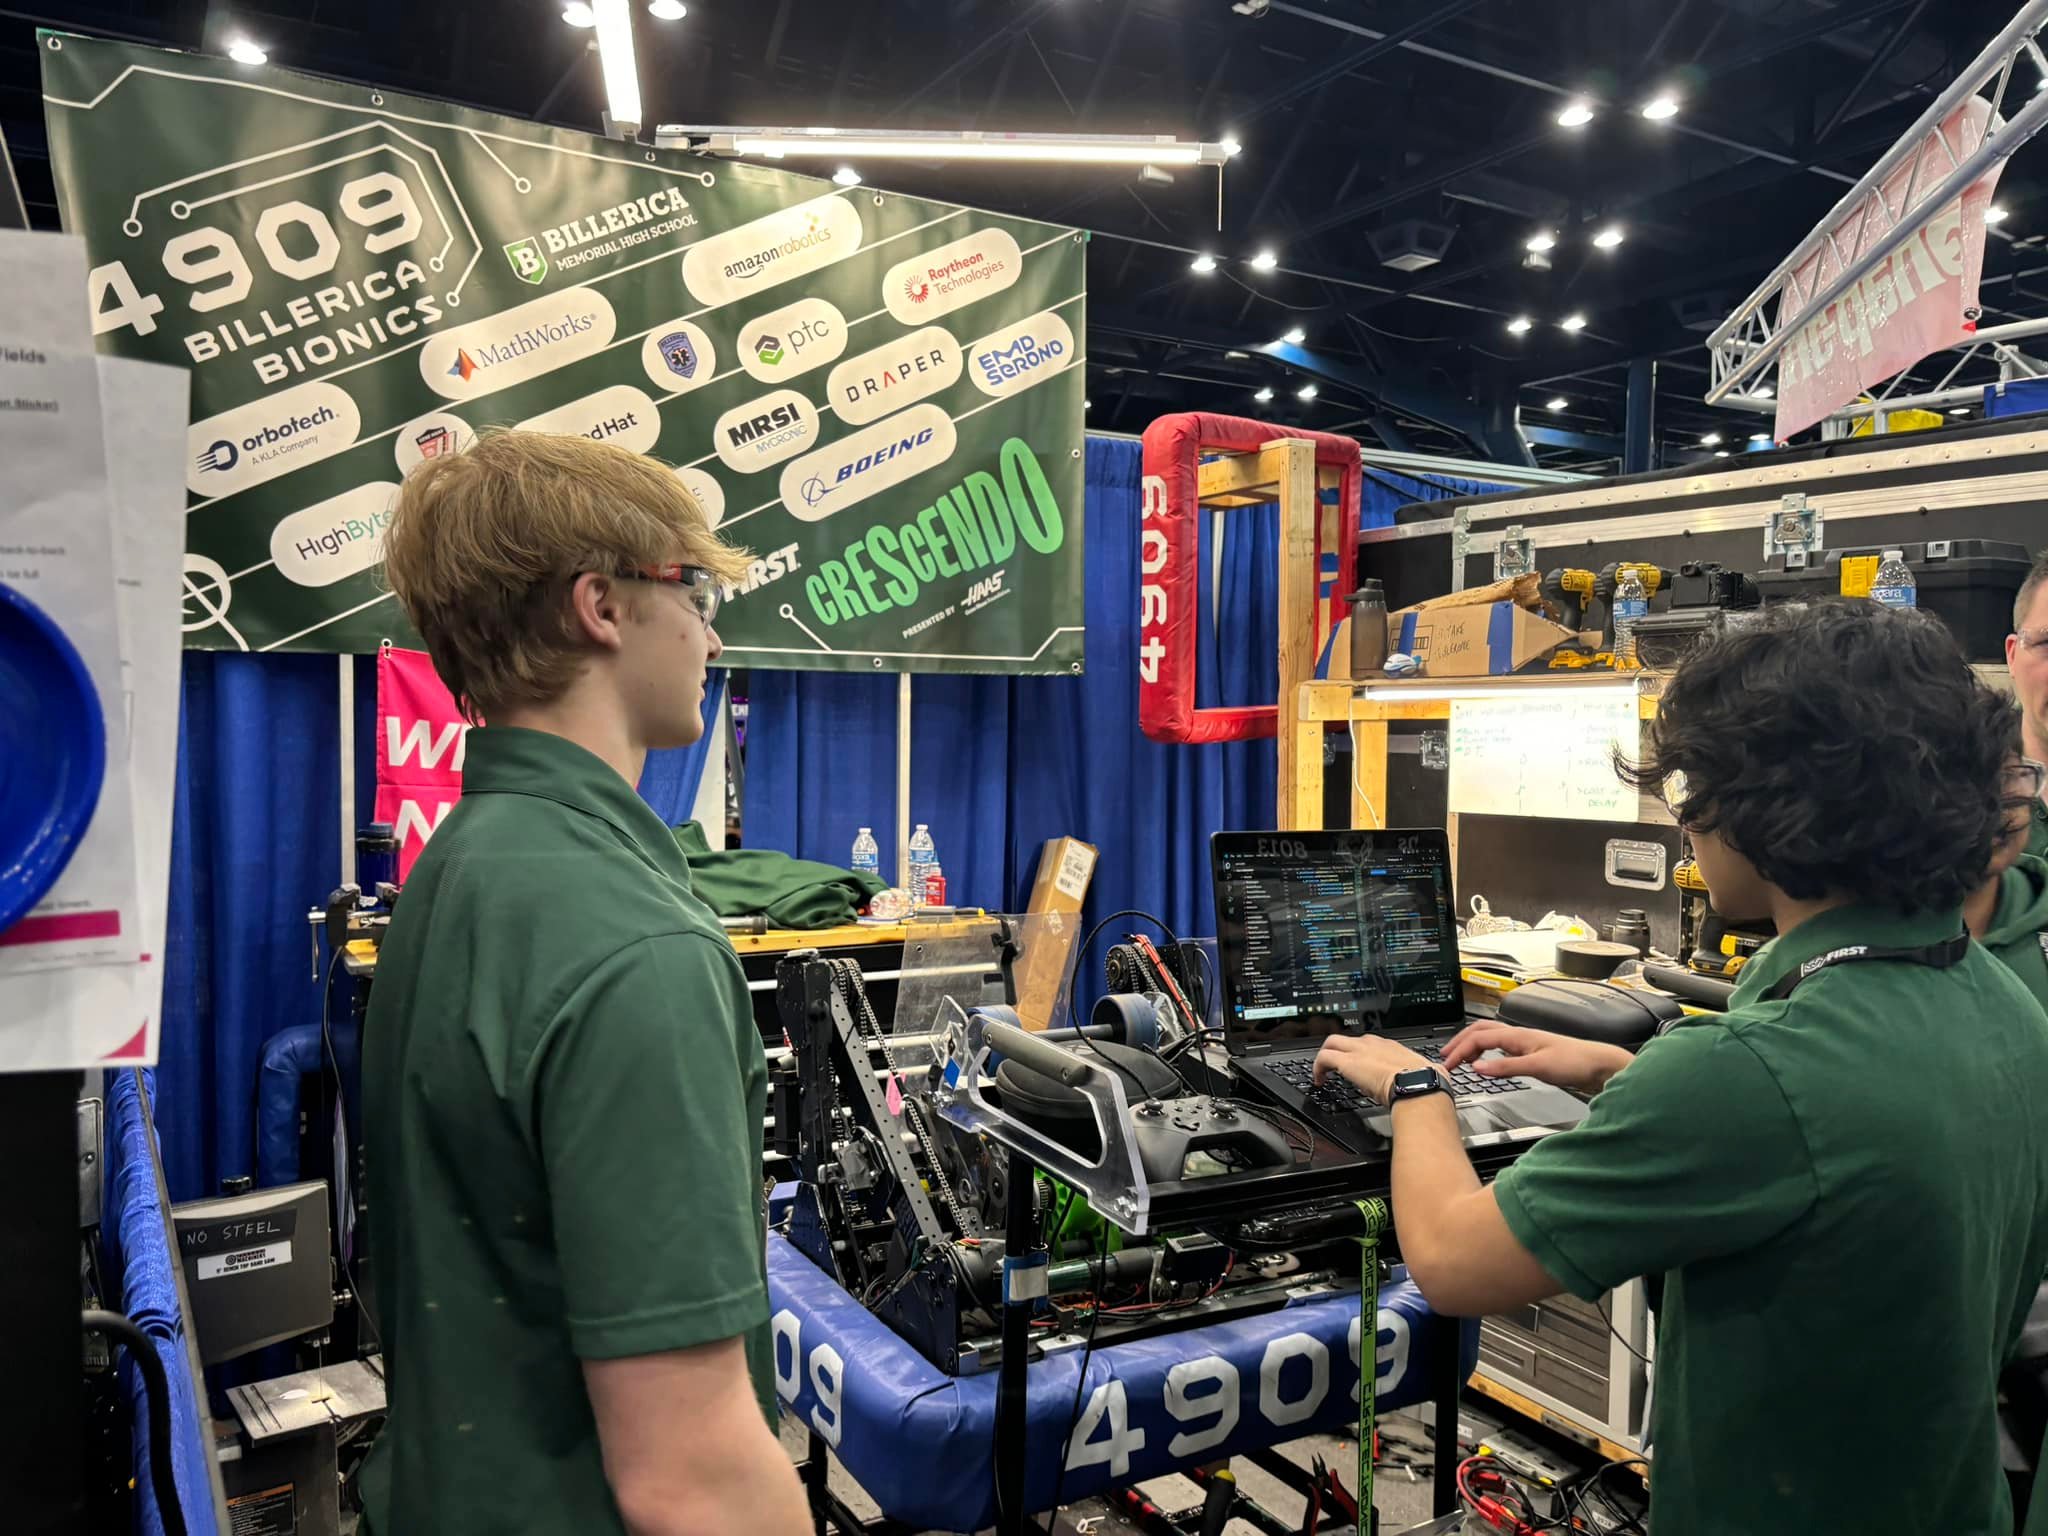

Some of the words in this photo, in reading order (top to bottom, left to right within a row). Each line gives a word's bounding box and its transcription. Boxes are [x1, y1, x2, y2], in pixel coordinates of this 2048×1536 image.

[542, 187, 689, 253] BILLERICA
[556, 241, 621, 271] MEMORIAL
[620, 230, 651, 249] HIGH
[650, 214, 698, 238] SCHOOL
[88, 171, 423, 337] 4909
[928, 253, 984, 283] Raytheon
[934, 260, 1005, 296] Technologies
[184, 260, 426, 363] BILLERICA
[253, 295, 443, 384] BIONICS
[476, 313, 592, 368] MathWorks
[788, 319, 830, 354] ptc
[978, 335, 1036, 371] EMD
[846, 350, 946, 402] DRAPER
[242, 406, 334, 451] orbotech
[603, 412, 638, 436] Hat
[728, 402, 800, 447] MRSI
[756, 424, 808, 454] MYCRONIC
[252, 456, 259, 465] A
[259, 448, 281, 463] KLA
[281, 435, 319, 455] Company
[836, 428, 934, 484] BOEING
[805, 437, 1064, 625] CRESCENDO
[961, 569, 1005, 606] HAAS
[1140, 475, 1168, 684] 4909
[902, 611, 945, 639] PRESENTED
[945, 605, 955, 616] BY
[1826, 946, 1868, 961] FIRST
[1343, 1018, 1361, 1027] DELL
[187, 1230, 208, 1245] NO
[222, 1221, 281, 1240] STEEL
[1062, 1308, 1411, 1478] 4909
